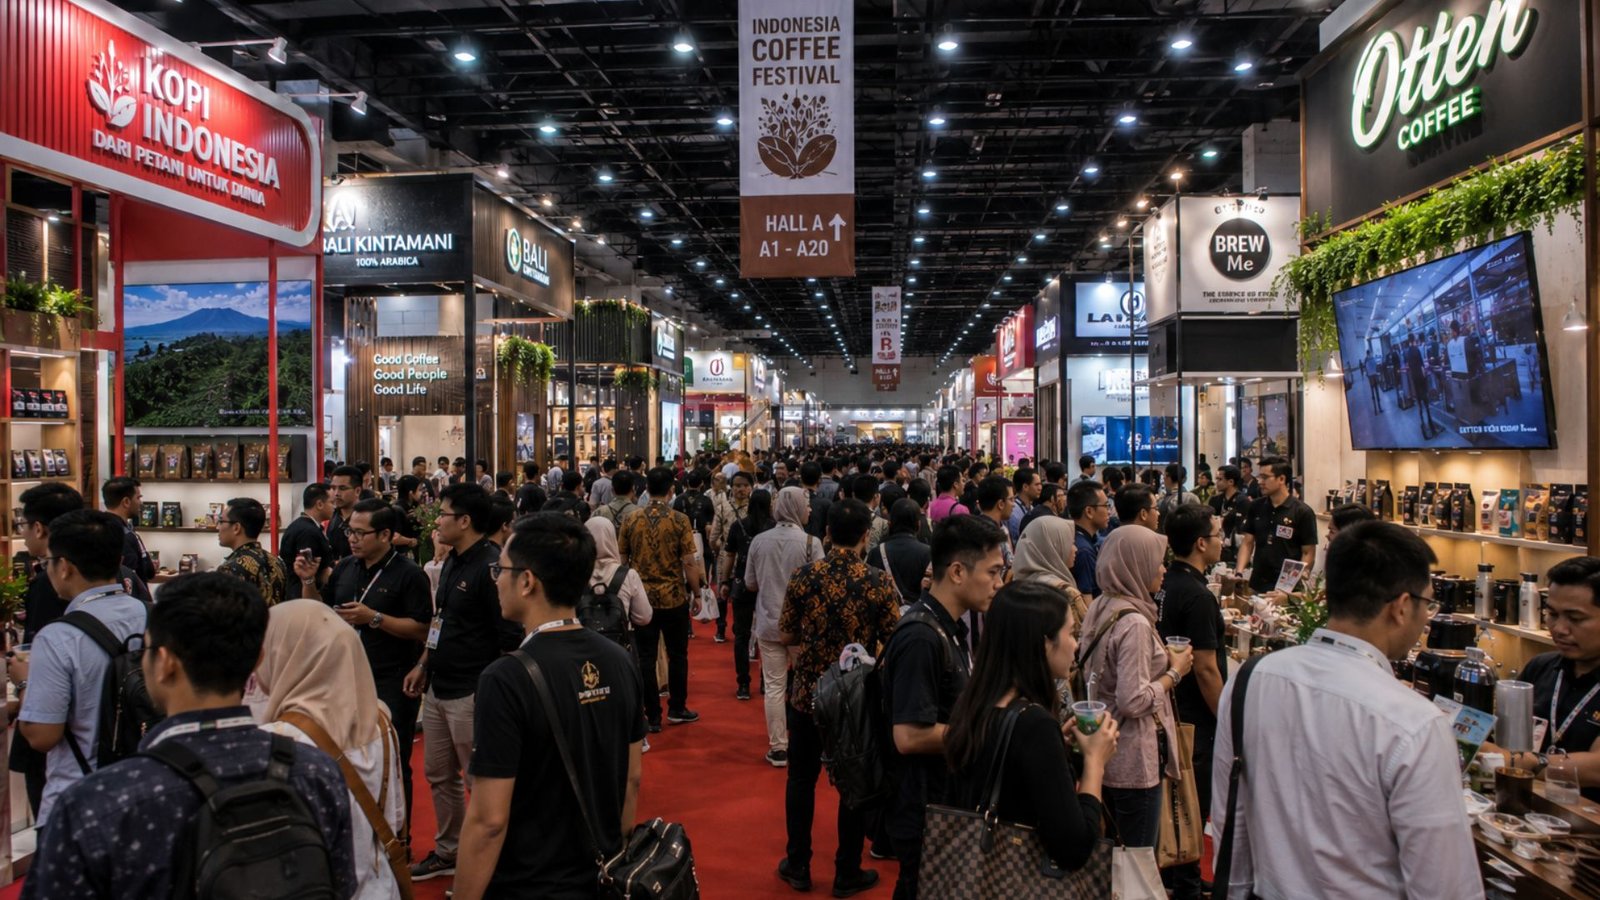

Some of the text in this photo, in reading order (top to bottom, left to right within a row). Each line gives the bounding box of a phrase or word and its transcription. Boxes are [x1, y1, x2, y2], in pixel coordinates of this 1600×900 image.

[752, 16, 841, 35] INDONESIA
[752, 36, 841, 62] COFFEE
[752, 65, 841, 86] FESTIVAL
[1351, 0, 1530, 148] Otten
[143, 57, 210, 120] KOPI
[1397, 88, 1476, 150] COFFEE
[142, 103, 281, 189] INDONESIA
[92, 129, 132, 159] DARI
[135, 144, 185, 177] PETANI
[187, 164, 229, 194] UNTUK
[765, 214, 824, 232] HALL A
[355, 233, 453, 252] KINTAMANI
[759, 240, 779, 257] A1
[796, 239, 829, 257] A20
[1214, 234, 1266, 253] BREW
[355, 255, 419, 268] 100% ARABICA
[523, 238, 548, 274] BALI
[1226, 254, 1254, 272] Me
[373, 353, 439, 366] Good Coffee
[373, 368, 448, 383] Good People
[373, 384, 428, 396] Good Life
